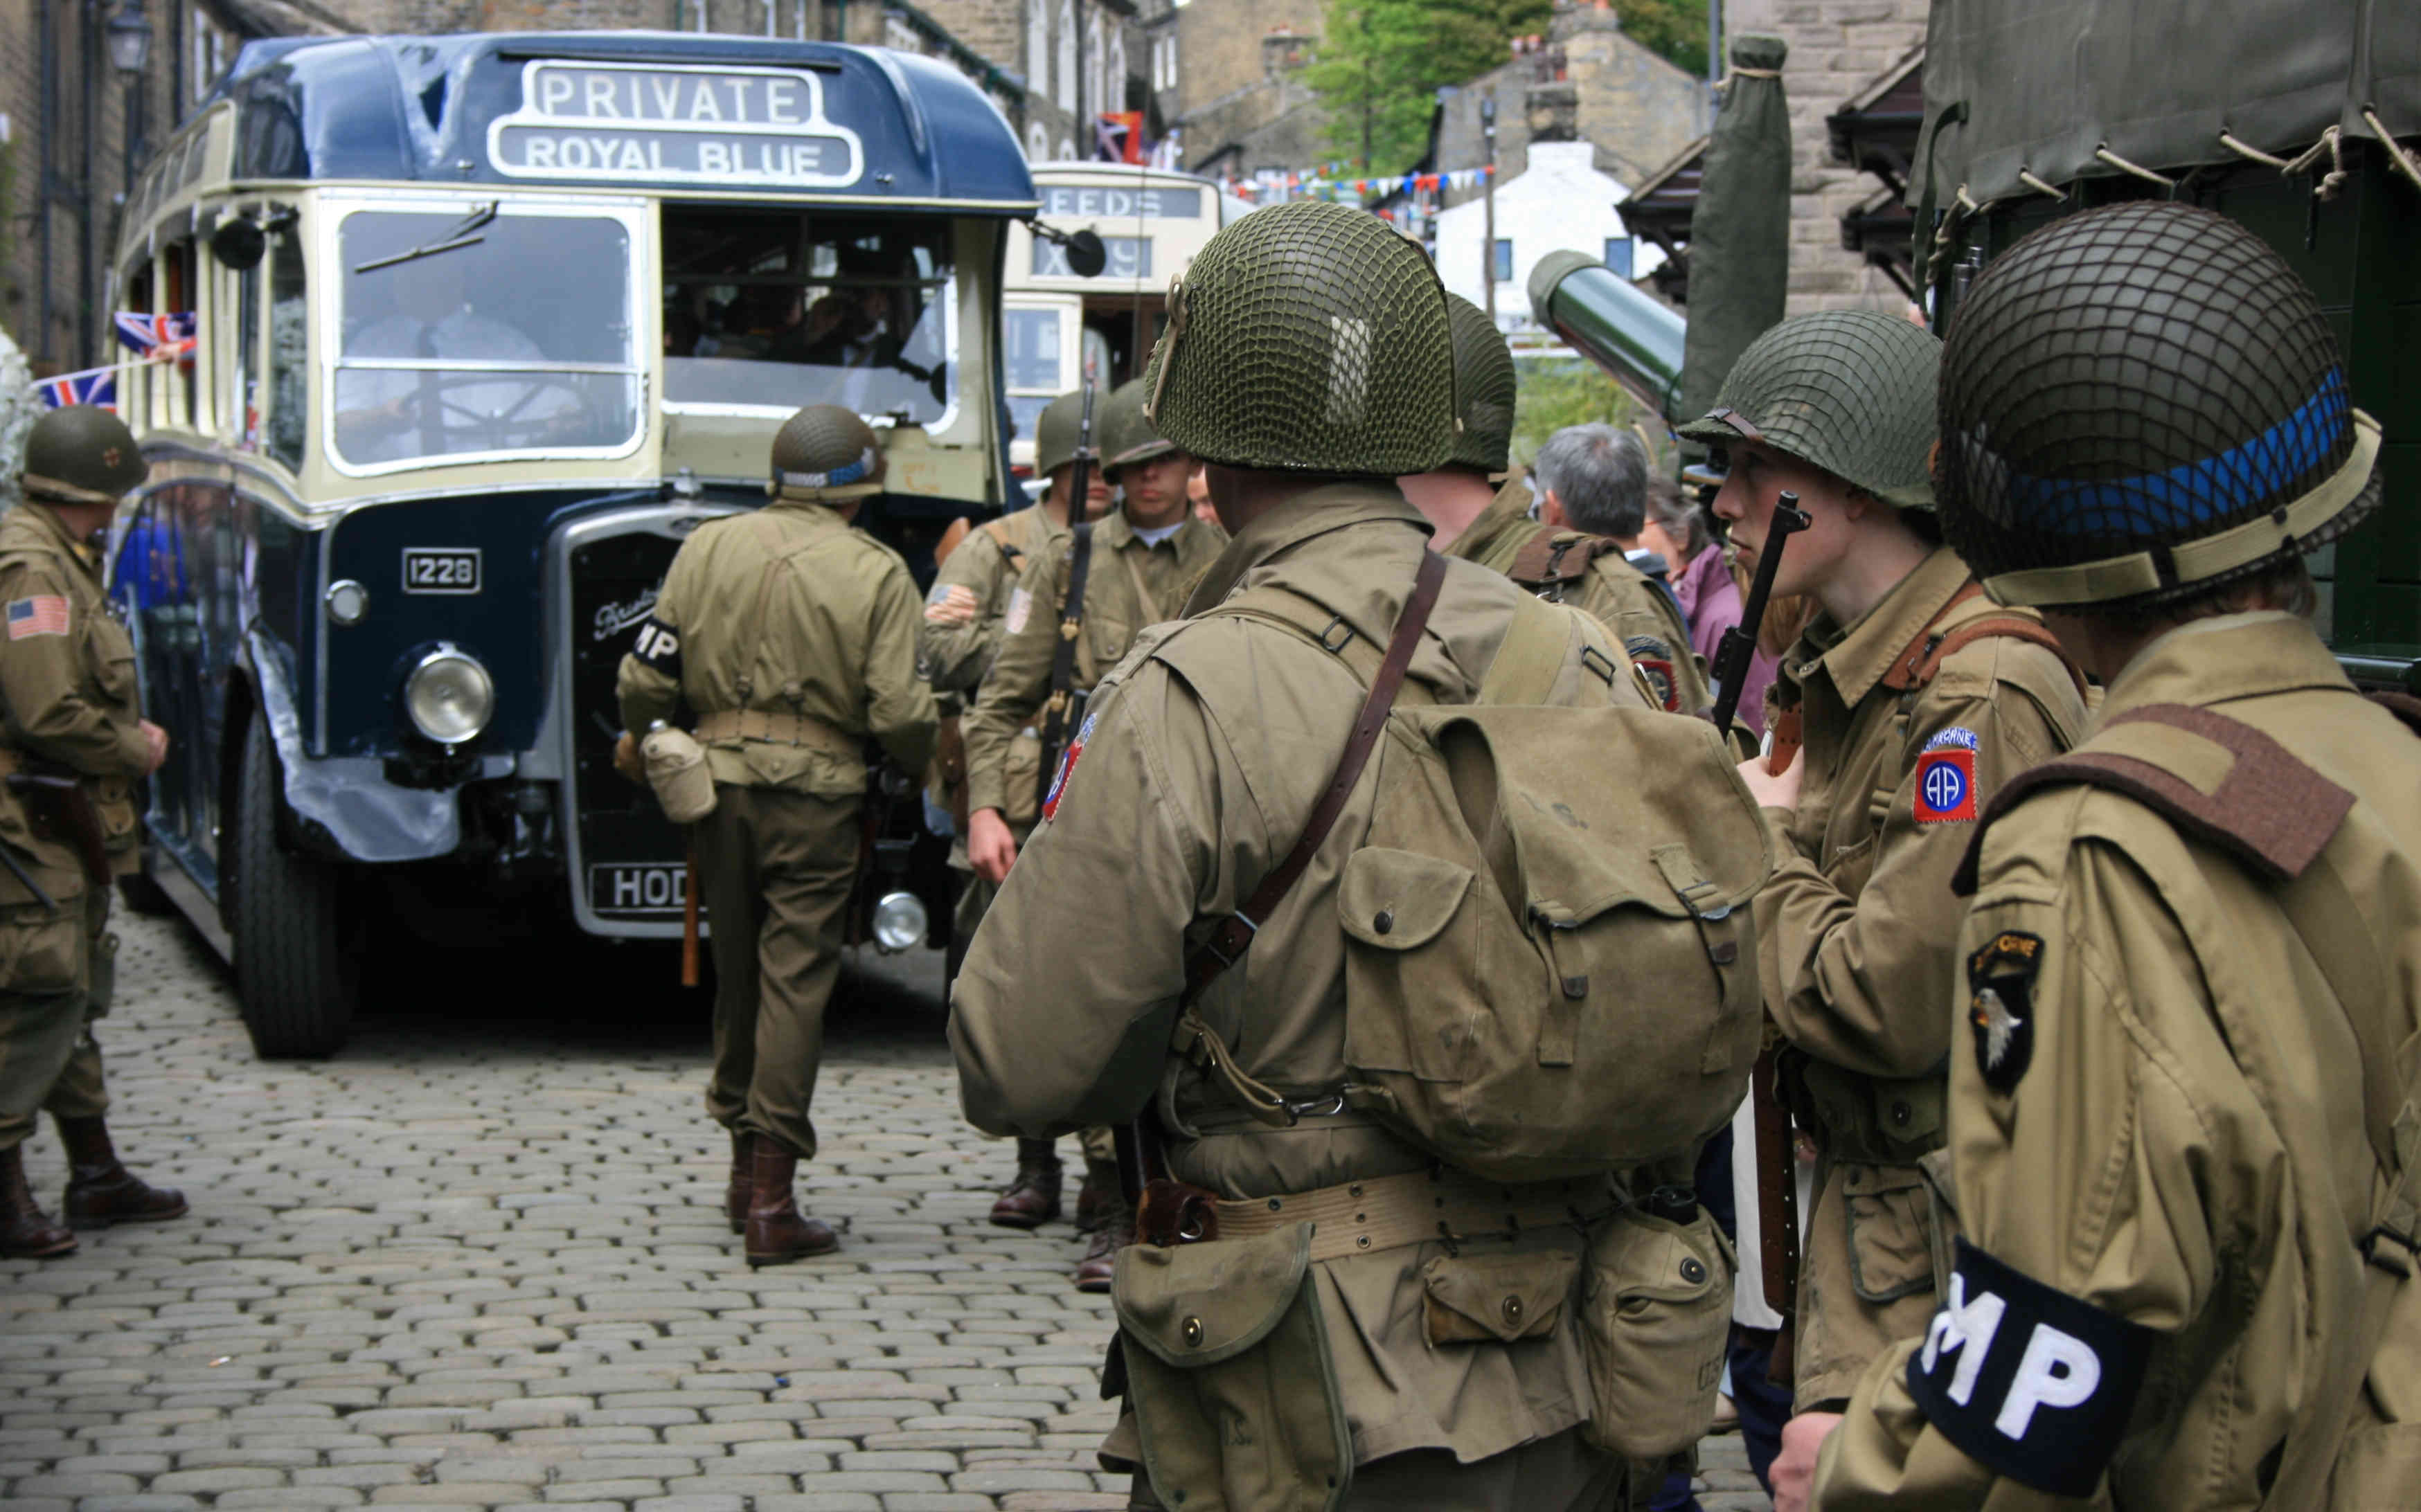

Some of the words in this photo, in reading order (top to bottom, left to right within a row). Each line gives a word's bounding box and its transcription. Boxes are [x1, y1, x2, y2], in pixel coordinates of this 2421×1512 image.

[542, 73, 801, 124] PRIVATE
[525, 136, 680, 171] ROYAL
[698, 141, 823, 177] BLUE
[1039, 189, 1162, 217] EEDS
[410, 557, 472, 583] 1228
[1926, 766, 1960, 807] AA
[1920, 1271, 2102, 1441] MP
